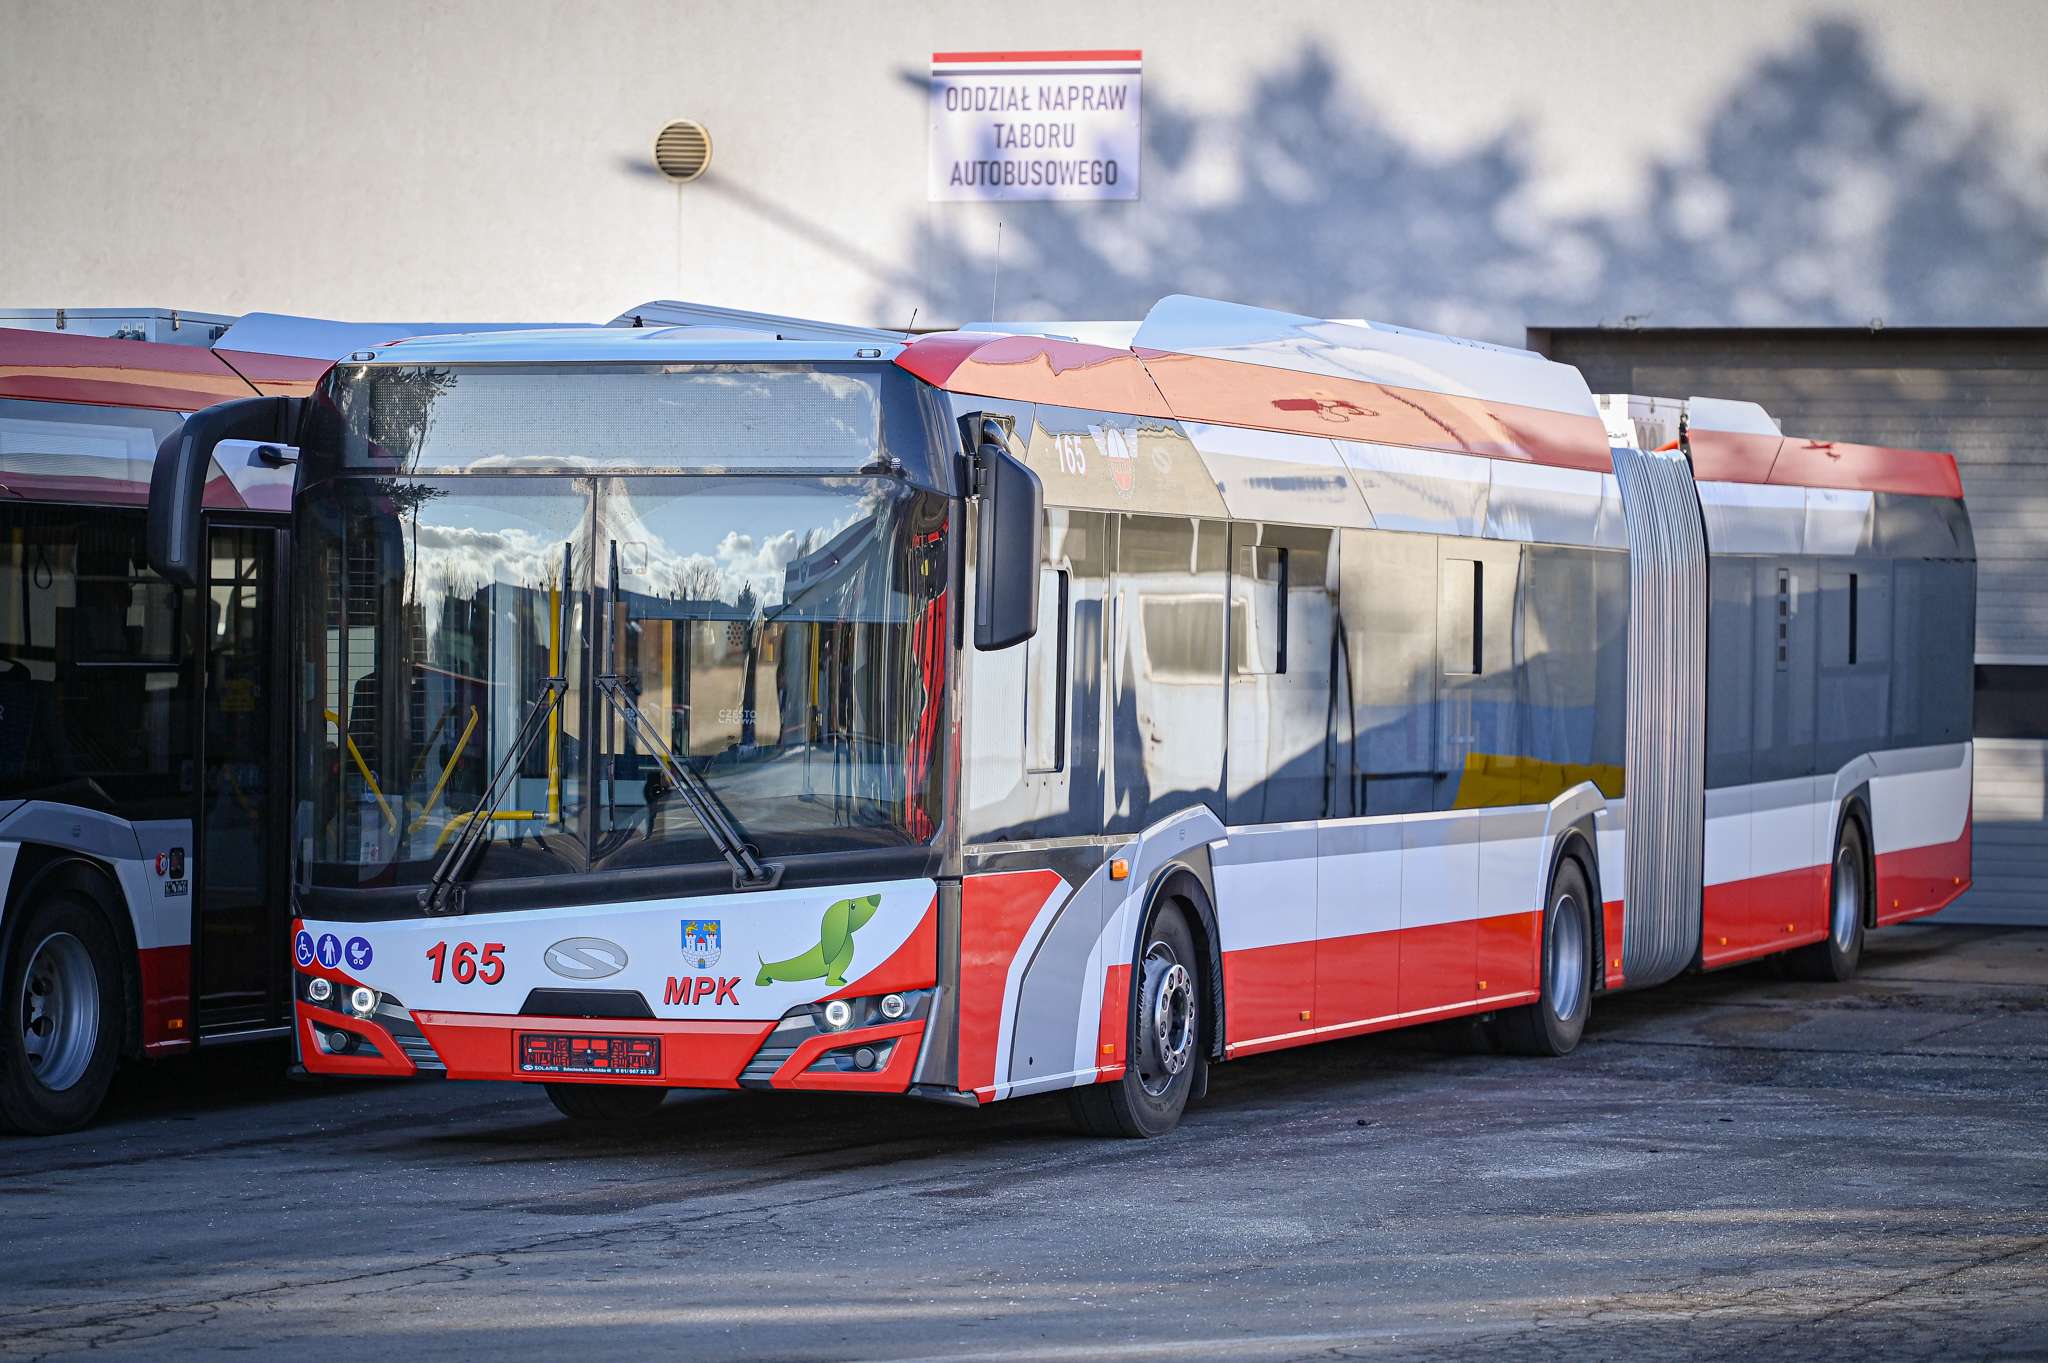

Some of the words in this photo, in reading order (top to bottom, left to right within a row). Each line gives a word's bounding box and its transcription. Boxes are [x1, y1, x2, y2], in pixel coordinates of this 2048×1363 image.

[946, 87, 1031, 111] ODDZIAŁ
[1038, 85, 1127, 110] NAPRAW
[993, 123, 1075, 148] TABORU
[950, 159, 1118, 187] AUTOBUSOWEGO
[1055, 434, 1086, 475] 165
[426, 941, 506, 985] 165
[664, 976, 742, 1005] MPK
